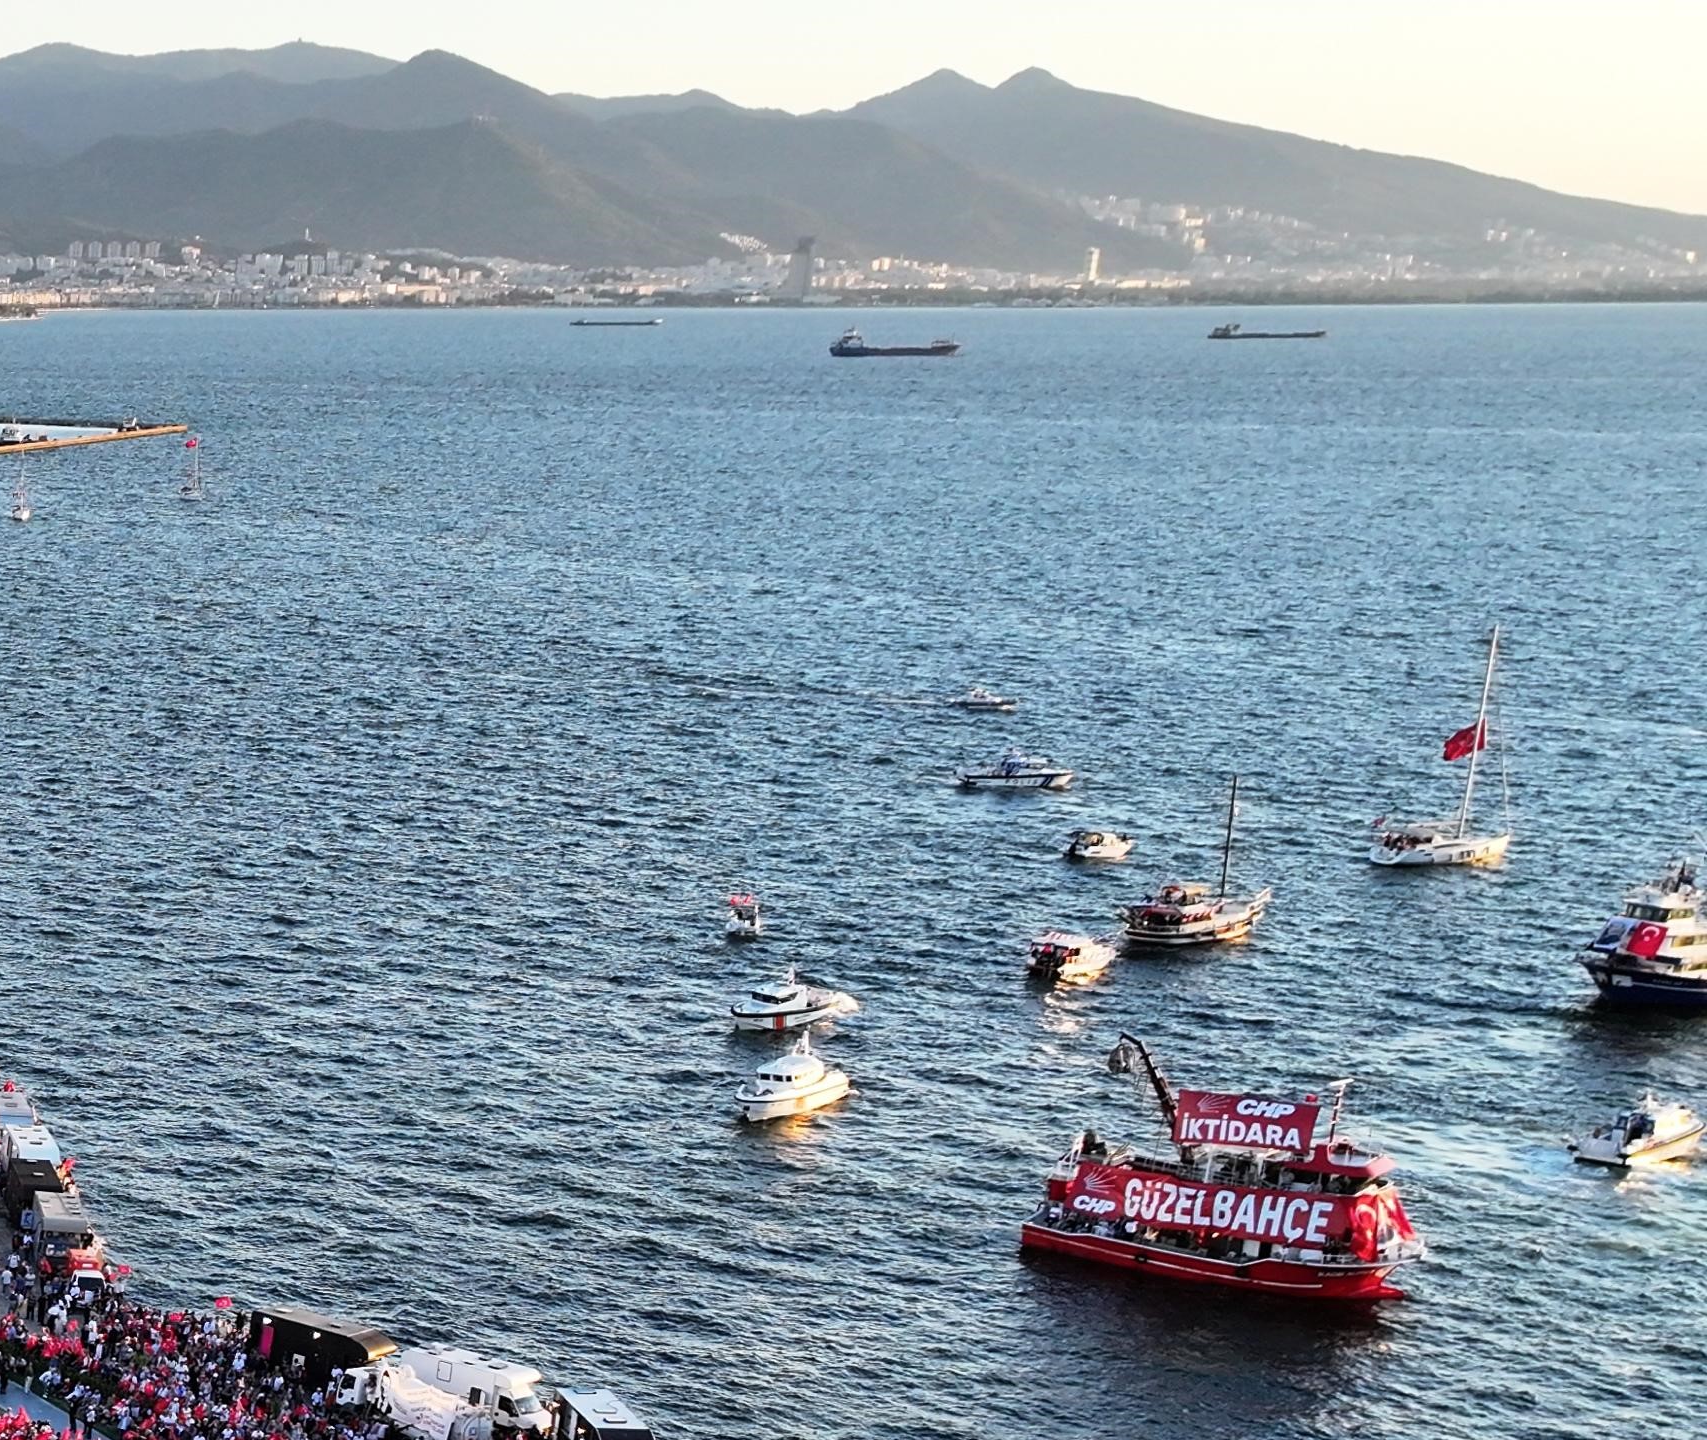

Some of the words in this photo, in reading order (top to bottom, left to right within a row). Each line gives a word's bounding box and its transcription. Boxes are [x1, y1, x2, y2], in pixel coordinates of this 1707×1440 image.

[1236, 1099, 1296, 1119] CHP
[1180, 1112, 1301, 1150] İKTİDARA
[1073, 1194, 1116, 1215] CHP
[1124, 1177, 1334, 1244] GÜZELBAHÇE
